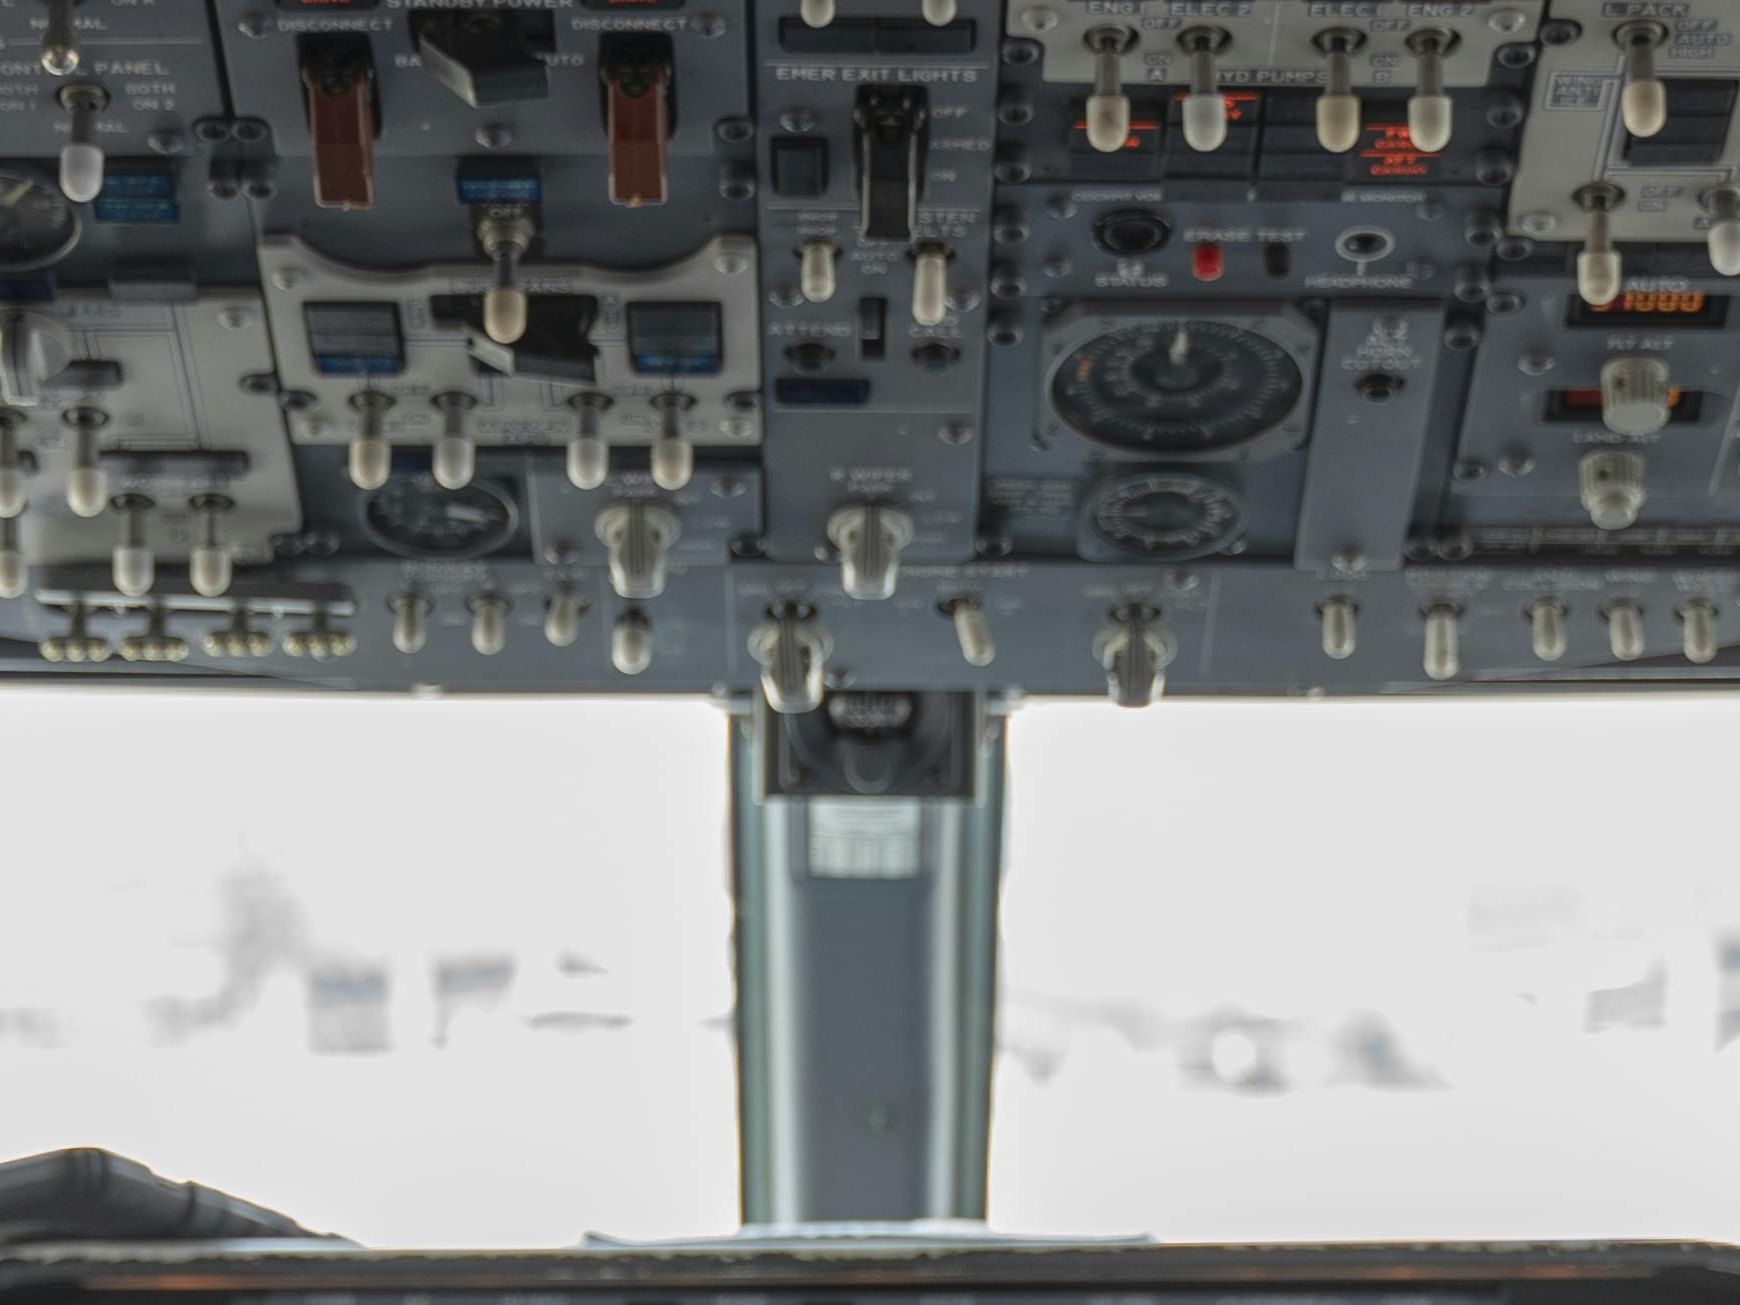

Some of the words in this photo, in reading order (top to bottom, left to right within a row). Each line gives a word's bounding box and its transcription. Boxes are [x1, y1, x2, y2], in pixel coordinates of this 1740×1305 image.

[1087, 3, 1136, 16] ENG
[1170, 4, 1231, 17] ELEC
[1406, 4, 1449, 17] ENG
[1627, 4, 1687, 17] PACK
[278, 18, 393, 32] DISCONNECT
[572, 18, 688, 32] DISCONNECT
[1675, 34, 1731, 46] AUTO
[95, 62, 171, 76] PANEL
[776, 67, 836, 81] EMER
[841, 67, 891, 82] EXIT
[897, 68, 979, 83] LIGHTS
[124, 82, 176, 96] BOTH
[1183, 227, 1251, 243] ERASE
[1257, 227, 1307, 243] TEST
[1094, 273, 1170, 289] STATUS
[1303, 275, 1413, 289] HEADPHONE
[1626, 278, 1690, 292] AUTO
[769, 321, 854, 337] ATTEND
